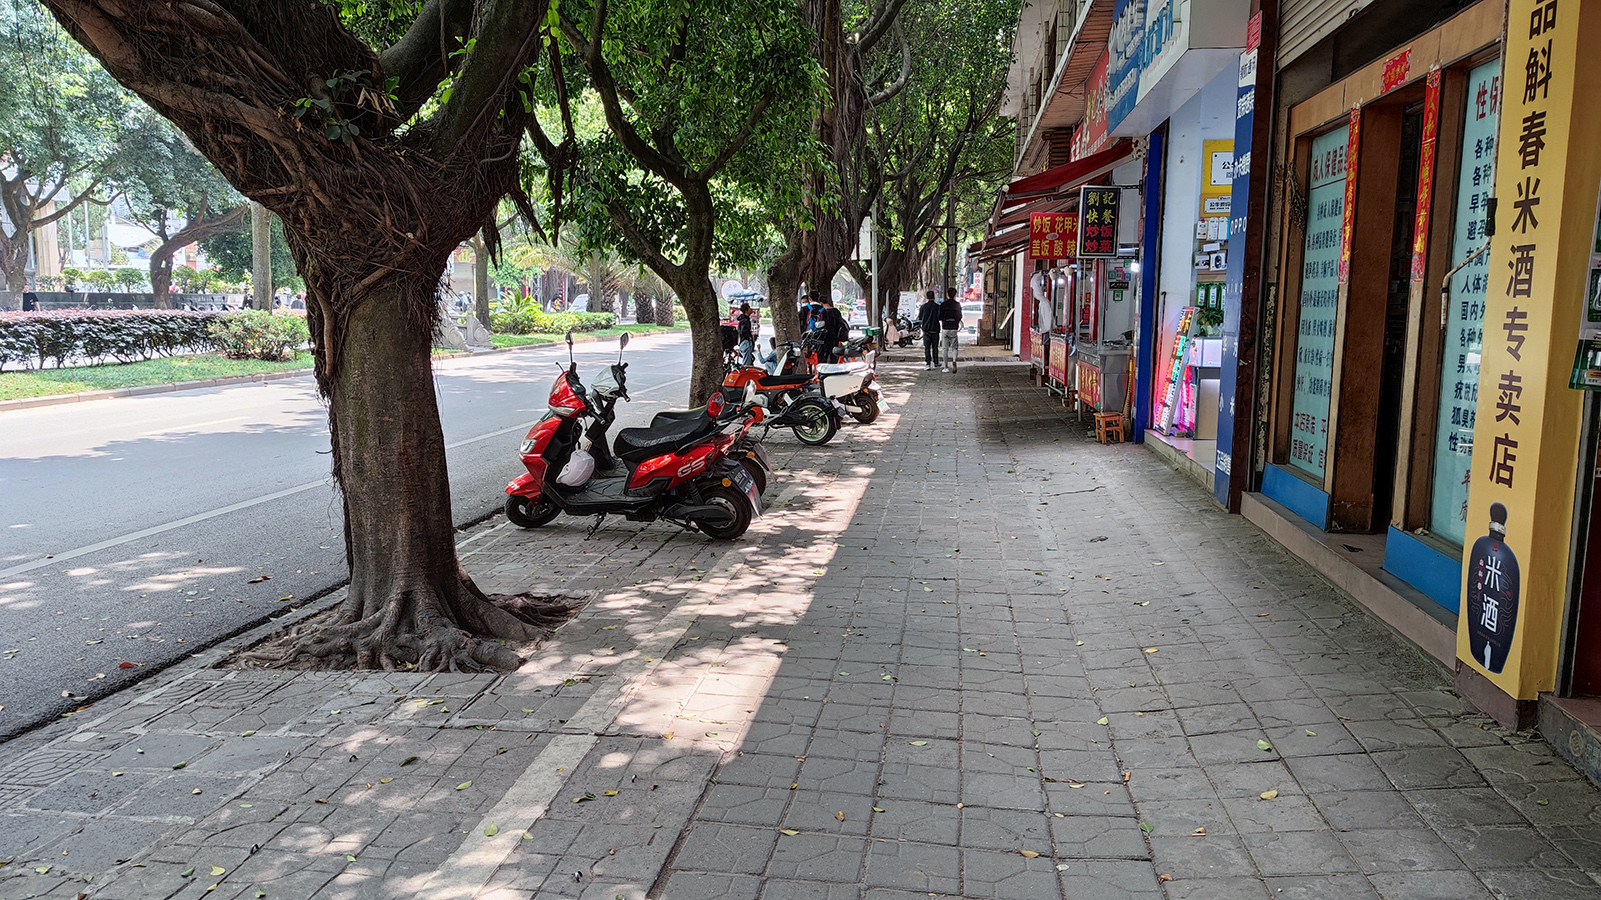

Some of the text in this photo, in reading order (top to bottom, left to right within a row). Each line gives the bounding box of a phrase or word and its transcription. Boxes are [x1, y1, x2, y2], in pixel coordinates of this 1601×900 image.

[1087, 191, 1116, 206] 劉記
[1032, 216, 1051, 233] 炒饭
[1086, 208, 1115, 224] 快餐
[1086, 225, 1113, 238] 炒饭
[1229, 216, 1247, 235] OPPO
[1031, 239, 1050, 257] 盖饭
[1085, 240, 1112, 253] 炒菜
[1489, 0, 1558, 489] 品斛春米酒专卖店
[677, 456, 705, 477] GS
[1481, 555, 1502, 633] 米酒
